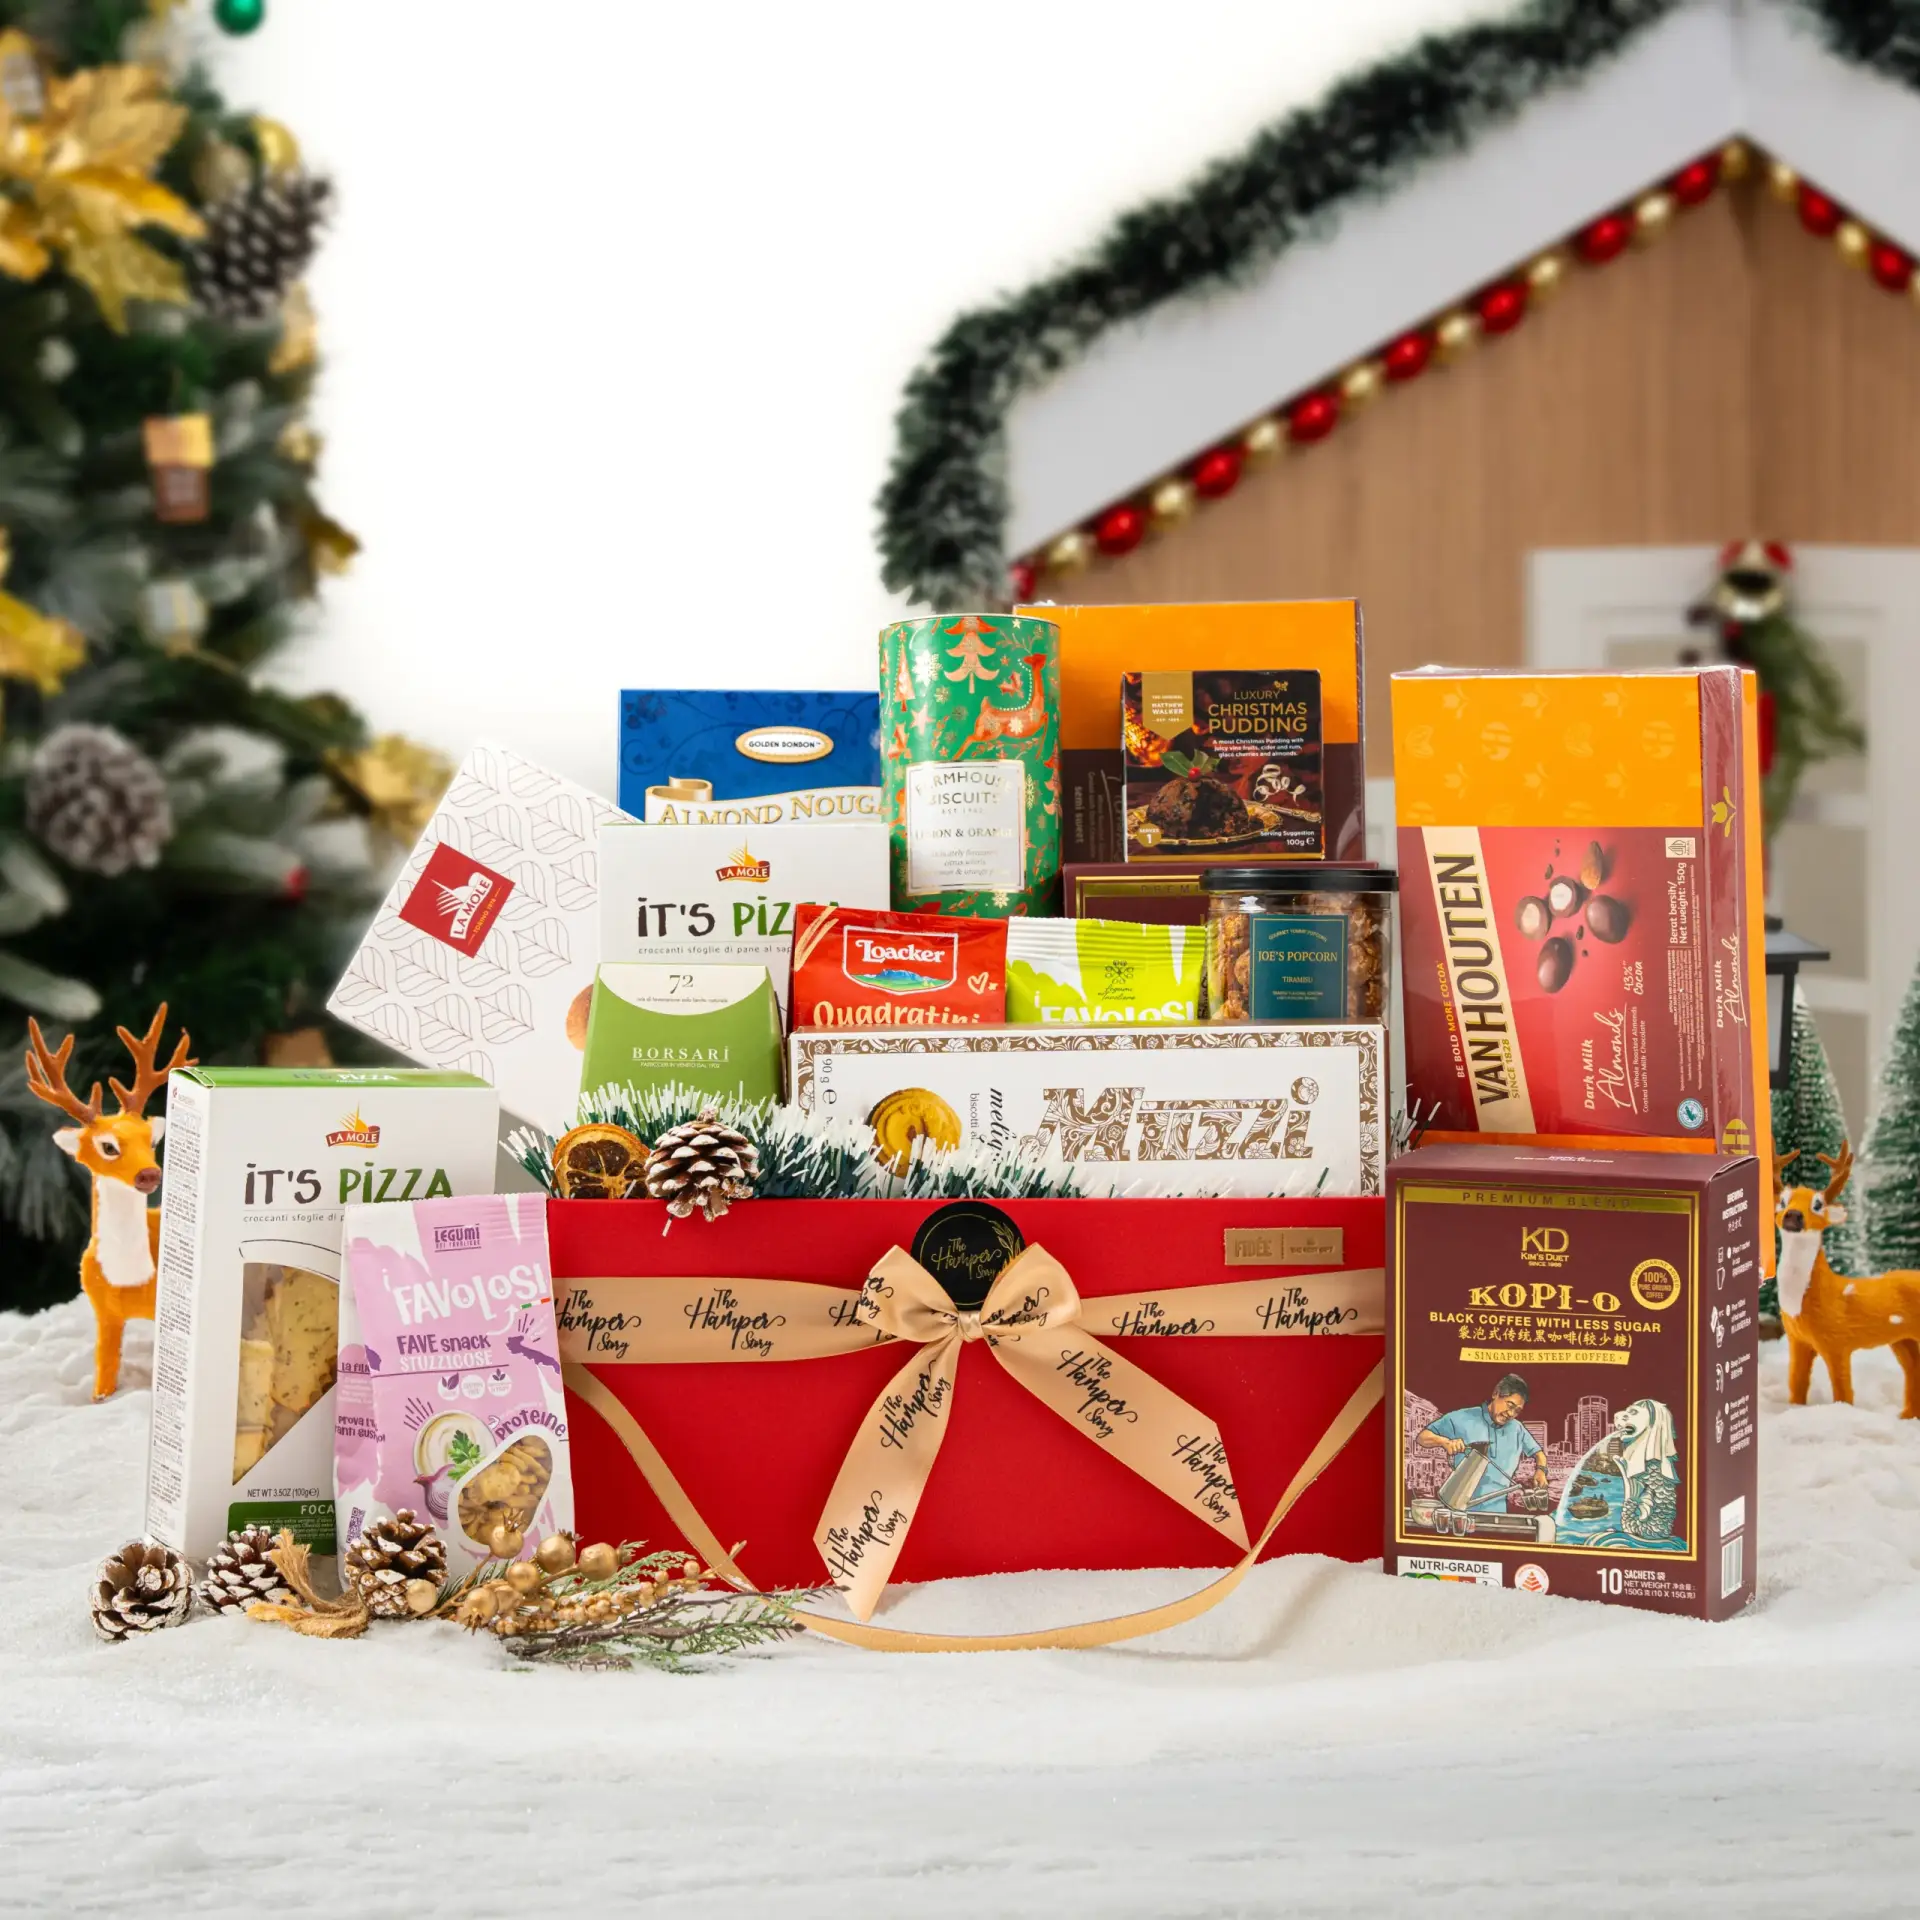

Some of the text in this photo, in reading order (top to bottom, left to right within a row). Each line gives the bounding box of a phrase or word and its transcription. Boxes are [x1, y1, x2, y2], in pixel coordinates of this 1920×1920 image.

[1234, 690, 1280, 700] LUXURY
[1208, 702, 1308, 717] CHRISTMAS
[1208, 717, 1308, 734] PUDDING
[658, 803, 783, 824] ALMOND
[1074, 786, 1085, 843] semi sweet
[956, 829, 964, 837] &
[1146, 834, 1152, 844] 1
[720, 866, 768, 879] LA MOLE
[454, 880, 490, 935] LA MOLE
[1667, 880, 1678, 944] Berat bersih/
[1677, 862, 1689, 944] Net weight: 150g
[638, 944, 772, 956] croccanti sfoglie di pane al
[855, 938, 946, 964] Loacker
[1258, 951, 1338, 962] JOE'S POPCORN
[669, 974, 694, 994] 72
[1282, 976, 1314, 984] TIRAMISU
[1433, 853, 1510, 1106] VAN HOUTEN
[1721, 932, 1744, 1024] Almonds
[1714, 959, 1724, 1028] Dark Milk
[1442, 1000, 1456, 1032] MORE
[1630, 1006, 1638, 1037] Almonds
[1452, 1034, 1464, 1062] BOLD
[1593, 1008, 1632, 1108] Almonds
[820, 1058, 833, 1084] 90 g
[1457, 1064, 1466, 1078] BE
[1503, 1038, 1520, 1100] SINCE 1828
[1581, 1039, 1596, 1110] Dark Milk
[970, 1093, 980, 1128] biscotti
[328, 1133, 377, 1145] LA MOLE
[1462, 1192, 1632, 1208] PREMIUM BLEND
[243, 1215, 288, 1223] croccanti
[292, 1213, 324, 1223] sfoglie
[328, 1213, 338, 1222] di
[434, 1224, 480, 1244] LEGUMI
[1521, 1226, 1570, 1253] KD
[931, 1237, 1002, 1280] The Hamper
[1521, 1252, 1570, 1262] KIM'S DUET
[1643, 1272, 1668, 1283] 100%
[570, 1288, 594, 1310] The
[714, 1288, 738, 1309] The
[1283, 1287, 1309, 1307] The
[1140, 1302, 1165, 1318] The
[1256, 1297, 1358, 1336] Hamper
[684, 1297, 786, 1350] Hamper
[1112, 1311, 1214, 1336] Hamper
[1429, 1312, 1661, 1333] BLACK COFFEE WITH LESS SUGAR
[396, 1334, 491, 1356] FAVE snack
[399, 1350, 494, 1372] STUZZICOSE
[1090, 1352, 1112, 1380] The
[1474, 1351, 1616, 1362] SINGAPORE STEEP COFFEE
[1056, 1350, 1138, 1424] Hamper
[879, 1394, 903, 1416] The
[880, 1359, 938, 1450] Hamper
[1206, 1436, 1227, 1465] The
[247, 1489, 260, 1498] NET
[262, 1489, 272, 1497] WT
[823, 1526, 849, 1549] The
[827, 1490, 890, 1578] Hamper
[1410, 1559, 1489, 1574] NUTRI-GRADE
[1624, 1570, 1656, 1580] SACHETS
[1596, 1568, 1622, 1594] 10
[1624, 1588, 1643, 1596] 150G
[1640, 1581, 1671, 1589] WEIGHT
